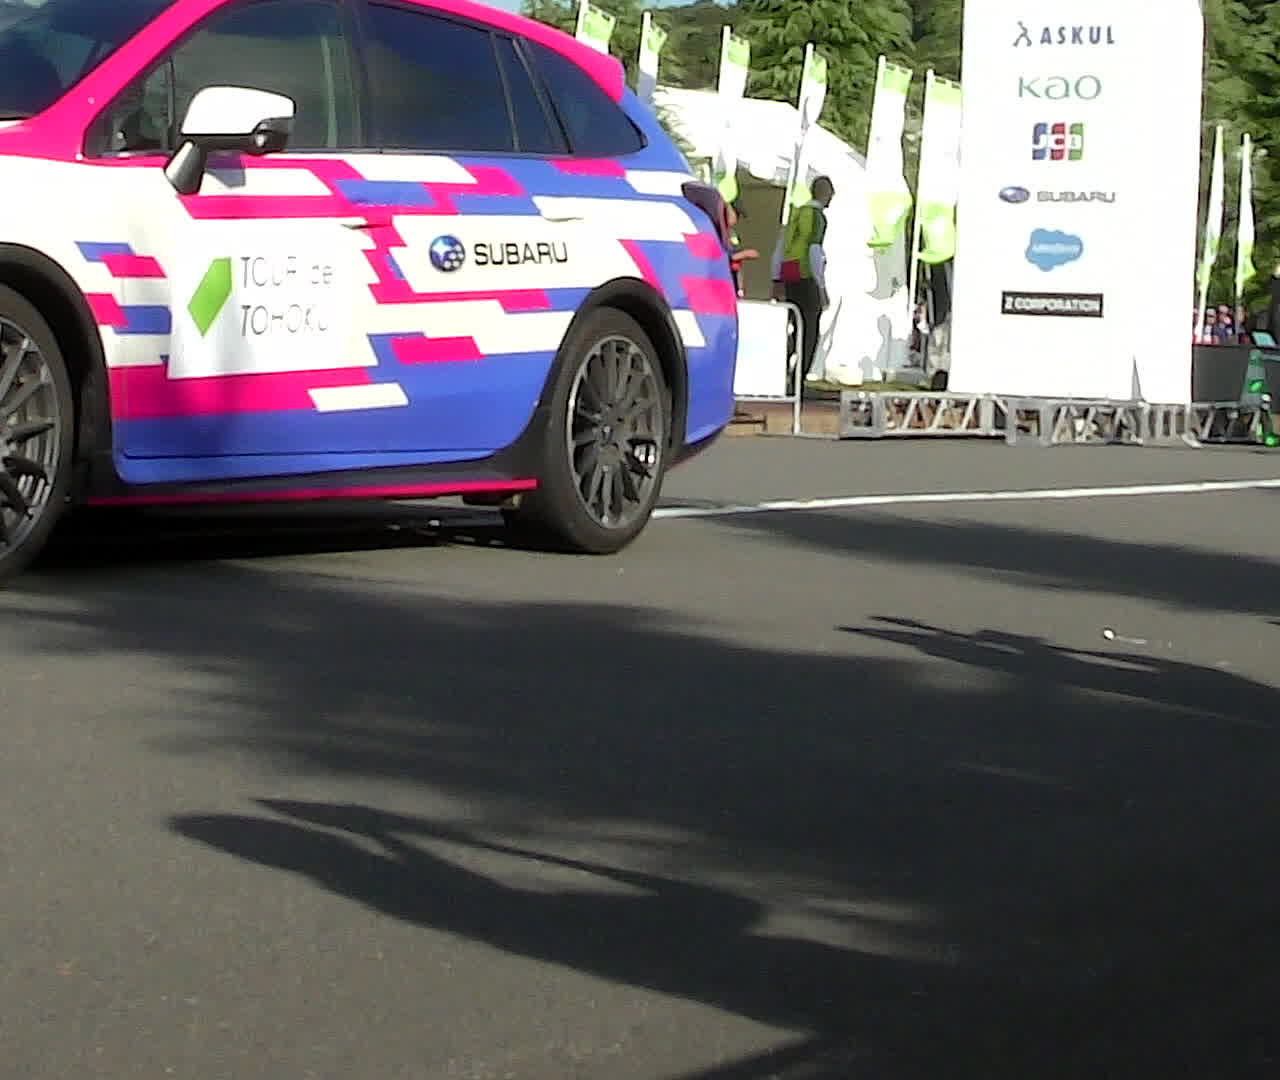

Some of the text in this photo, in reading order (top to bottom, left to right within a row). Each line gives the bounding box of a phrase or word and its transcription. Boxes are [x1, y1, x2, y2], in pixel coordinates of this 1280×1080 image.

[1039, 25, 1116, 46] ASKUL
[1036, 190, 1116, 204] SUBARU
[472, 240, 569, 266] SUBARU
